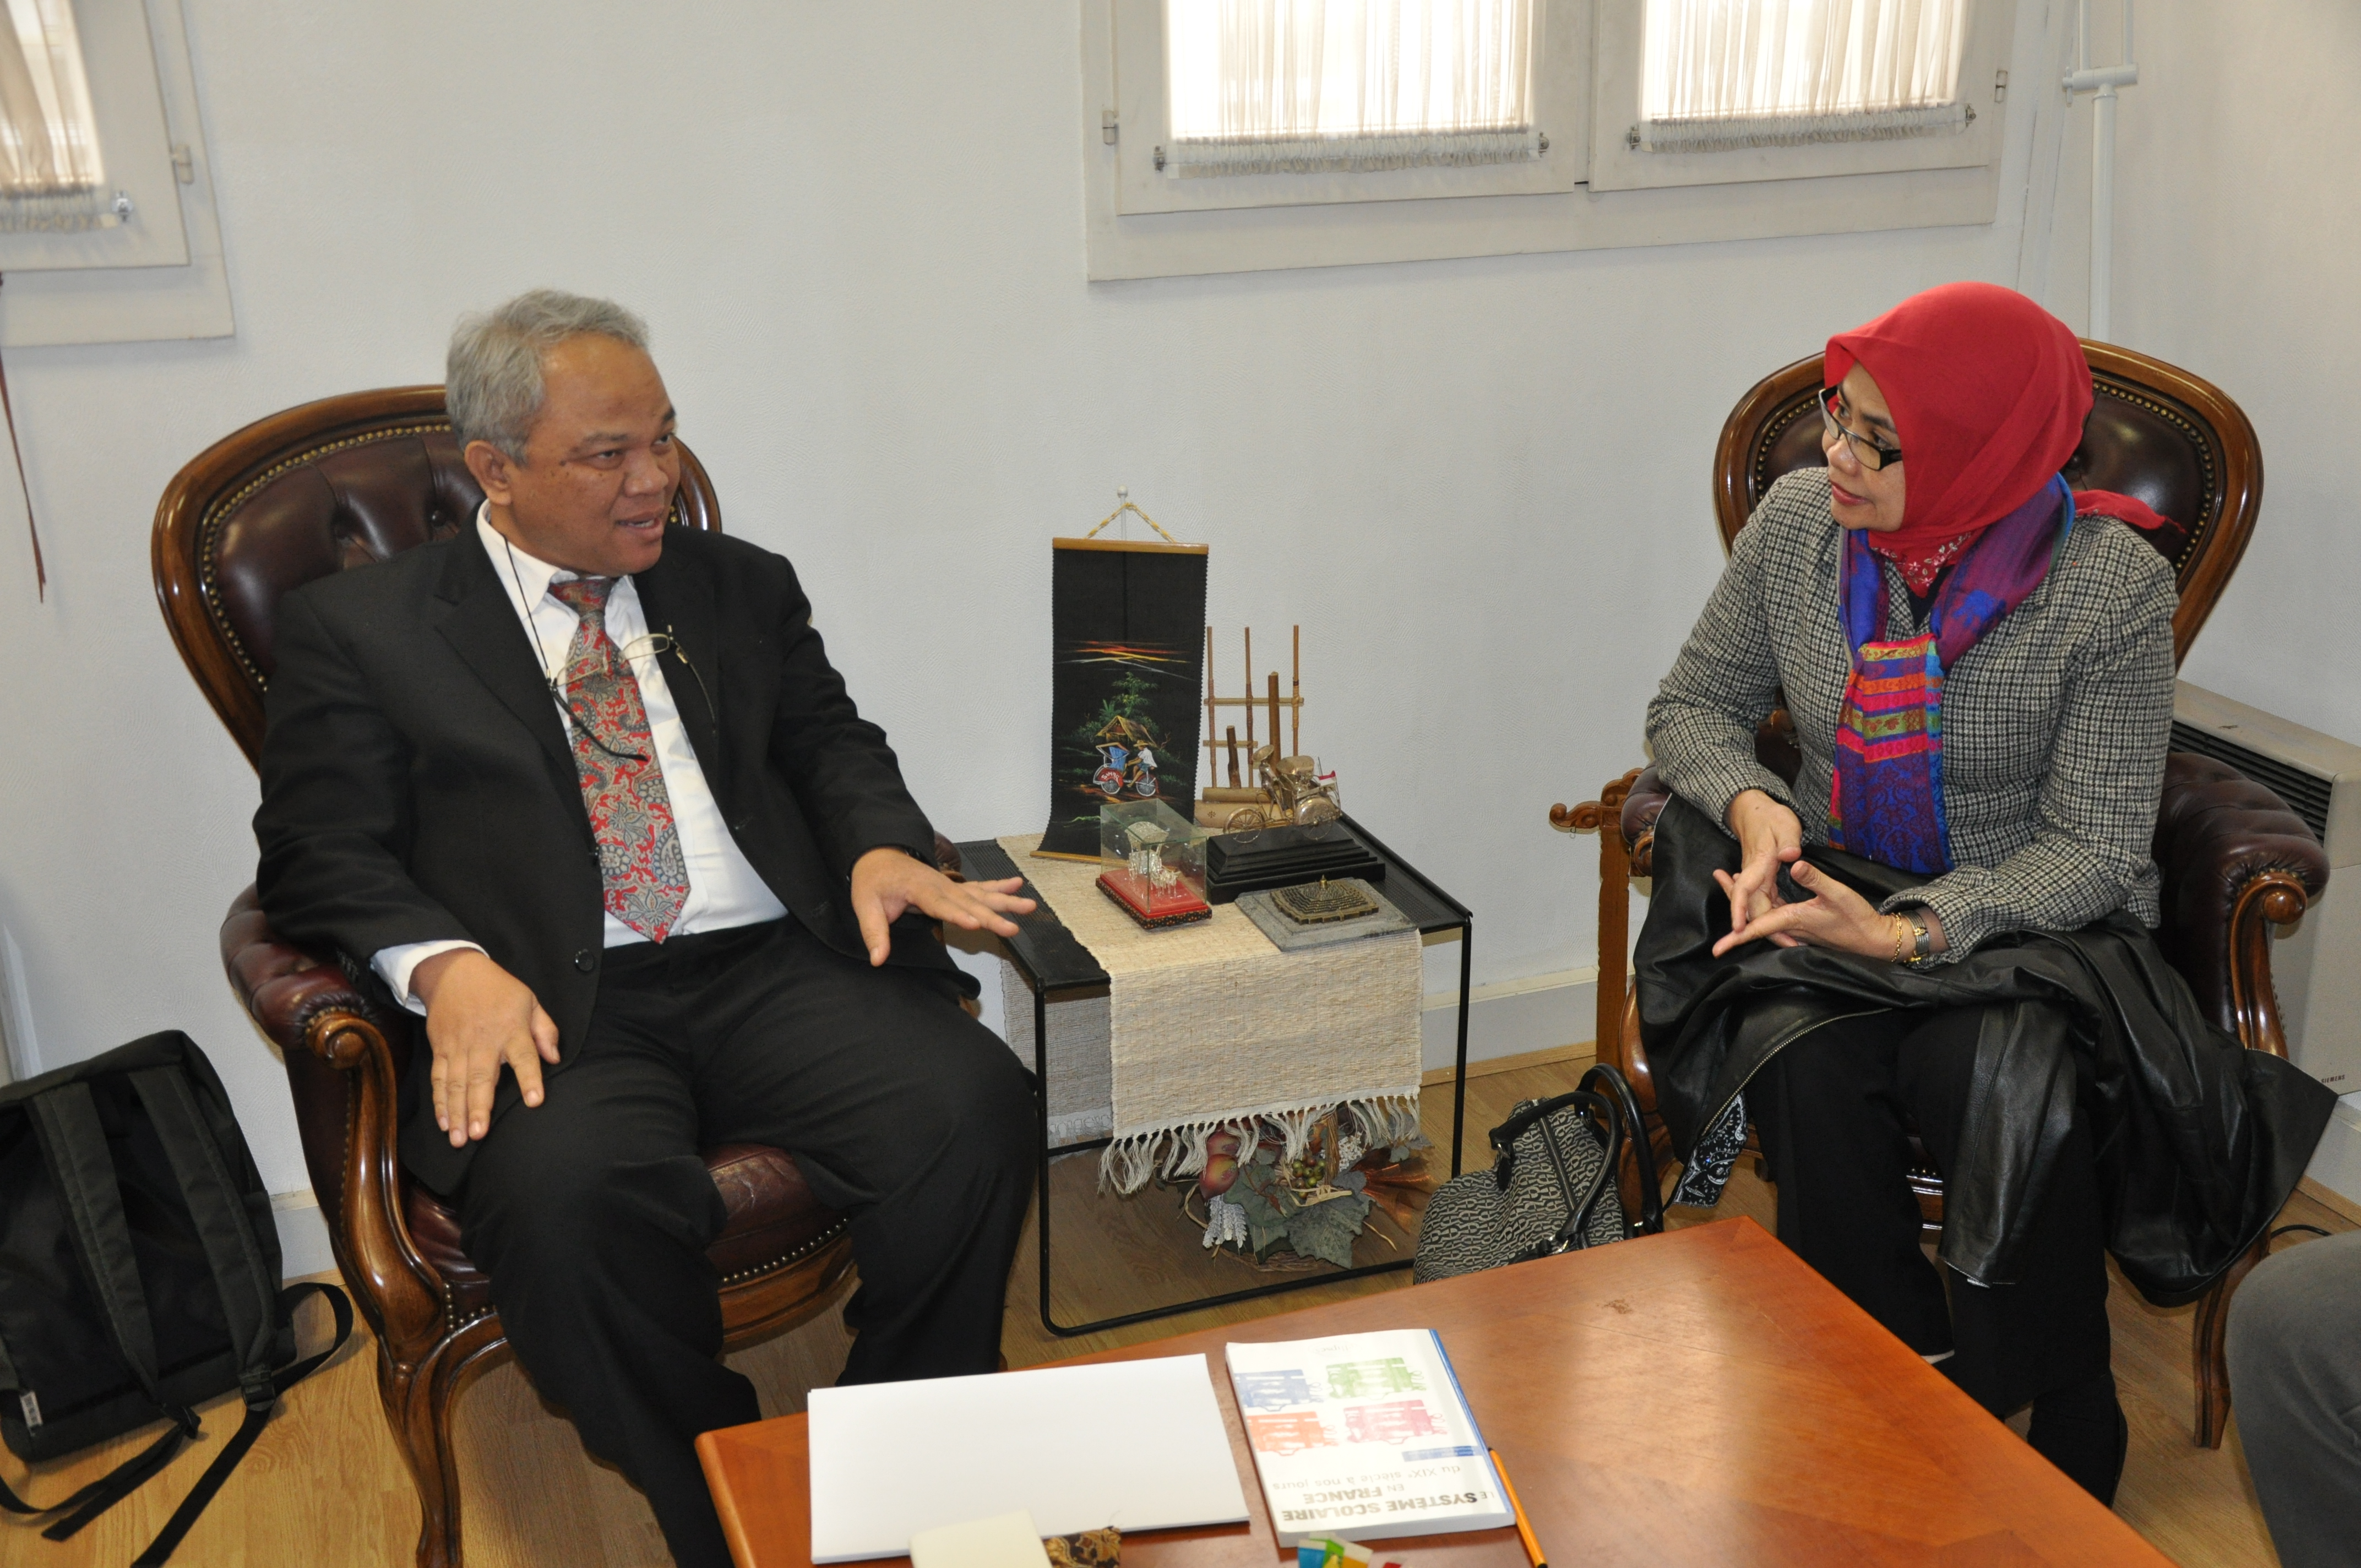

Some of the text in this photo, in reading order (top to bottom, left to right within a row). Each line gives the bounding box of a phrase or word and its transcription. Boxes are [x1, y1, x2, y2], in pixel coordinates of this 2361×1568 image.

[2321, 1074, 2345, 1084] SIEMENS
[1441, 1465, 1460, 1474] du
[1346, 1477, 1355, 1485] à
[1361, 1472, 1401, 1482] siècle
[1273, 1479, 1309, 1490] jours
[1315, 1478, 1341, 1487] nos
[1303, 1484, 1404, 1504] EN FRANCE
[1385, 1493, 1477, 1511] SYSTÈME
[1282, 1502, 1381, 1521] SCOLAIRE
